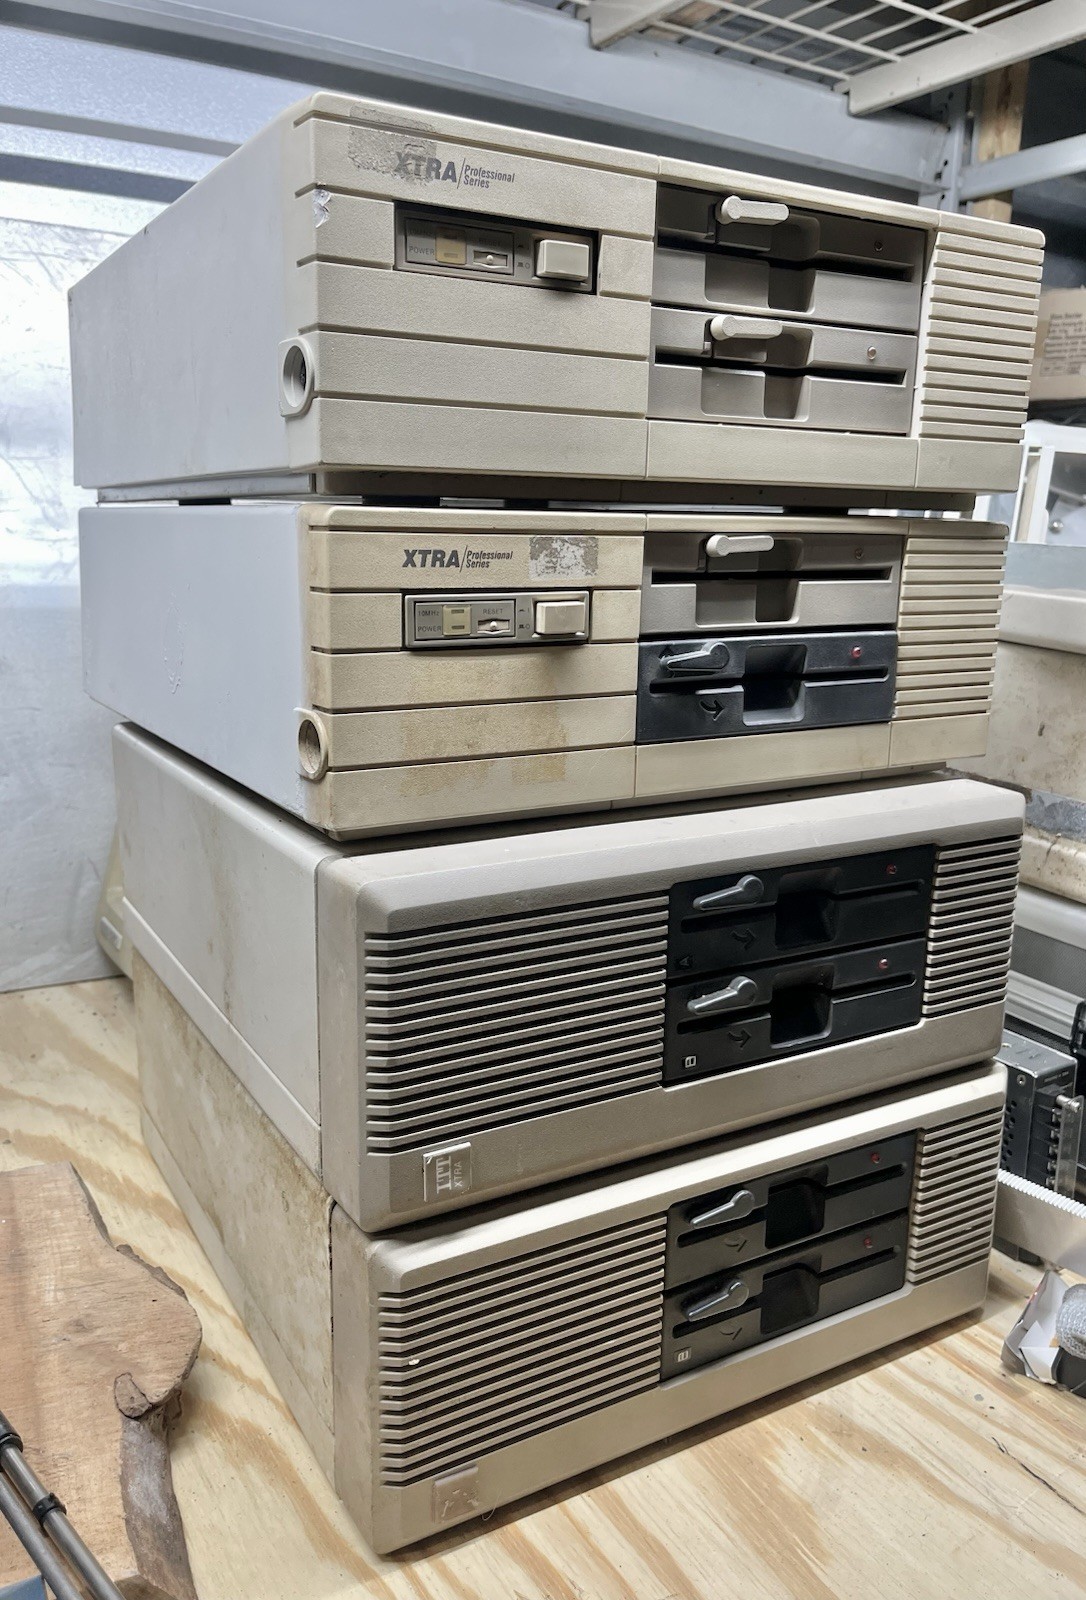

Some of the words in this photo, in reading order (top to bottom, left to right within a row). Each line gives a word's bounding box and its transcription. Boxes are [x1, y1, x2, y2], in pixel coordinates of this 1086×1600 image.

[464, 164, 515, 183] Professional
[463, 175, 490, 189] Series
[408, 245, 435, 256] POWER
[402, 549, 460, 568] XTRA
[466, 550, 514, 560] Professional
[465, 559, 490, 569] Series
[418, 609, 440, 617] 10MHz
[685, 1056, 697, 1068] B
